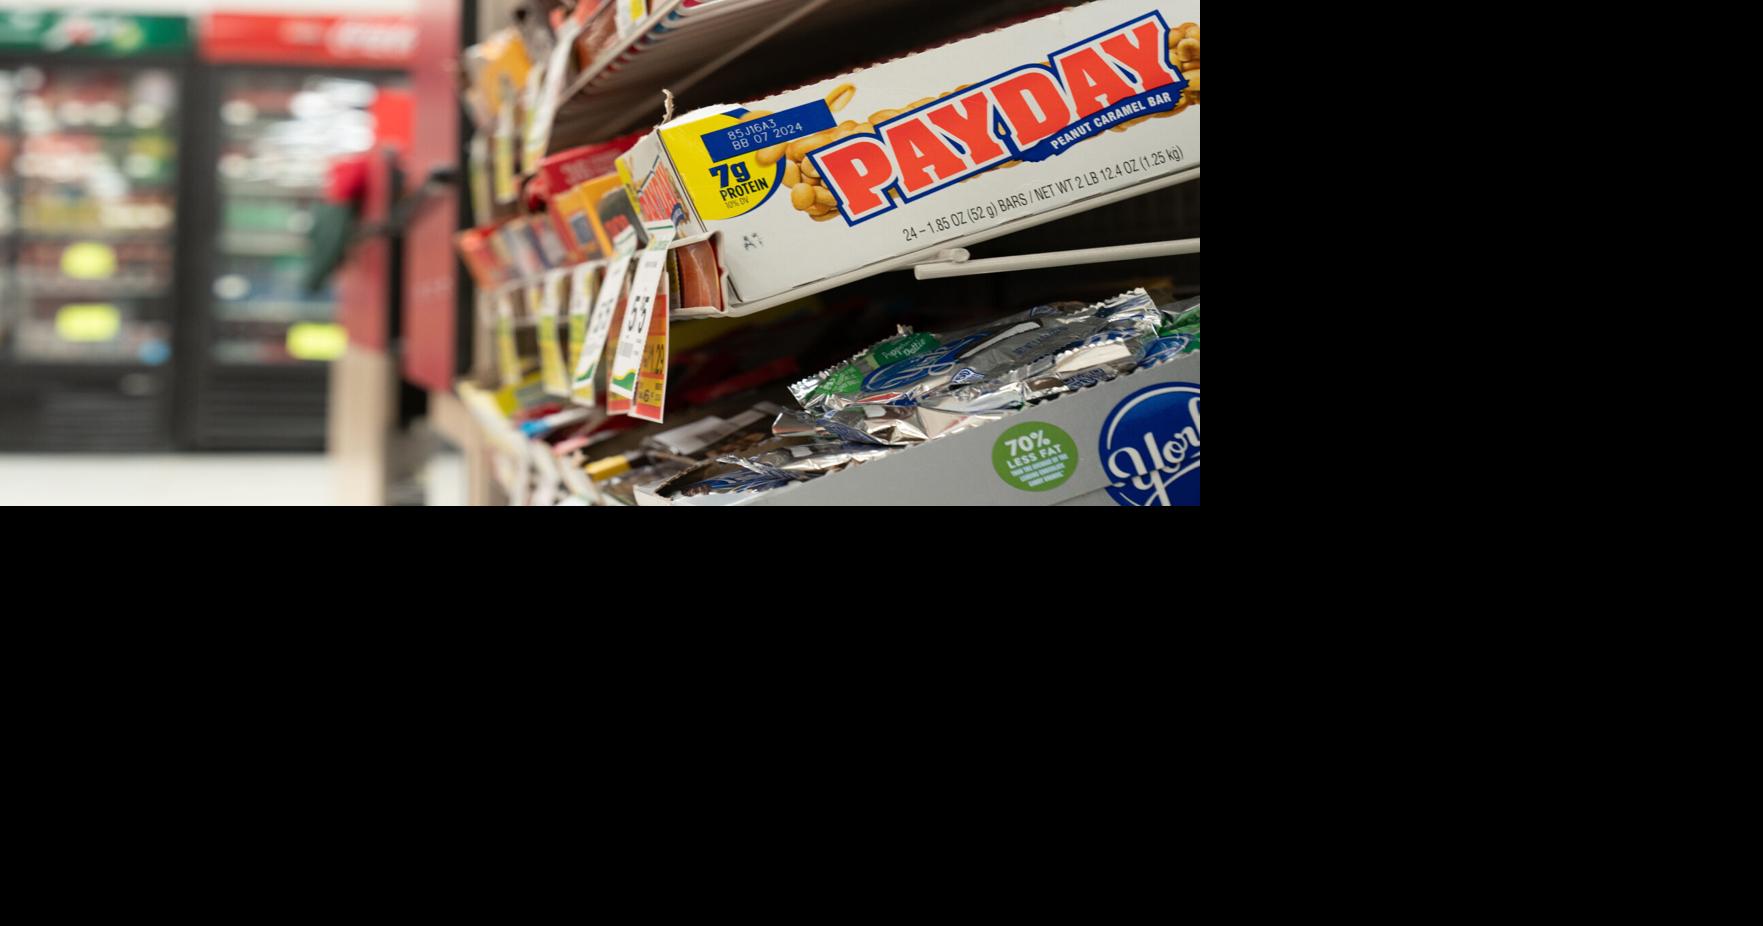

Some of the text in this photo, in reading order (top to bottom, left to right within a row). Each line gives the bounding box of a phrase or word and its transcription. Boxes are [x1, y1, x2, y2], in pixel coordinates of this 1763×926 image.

[727, 119, 777, 141] 85J16A3
[815, 16, 1180, 220] PAYDAY
[1050, 92, 1171, 149] PEANUT CARAMEL BAR
[732, 122, 802, 150] BB 07 2024
[709, 161, 751, 188] 7g
[720, 177, 769, 201] PROTEIN
[903, 226, 918, 241] 24
[927, 217, 950, 234] 1.85
[951, 211, 967, 226] OZ
[967, 206, 985, 223] (52
[987, 202, 998, 219] g)
[998, 193, 1028, 212] BARS
[1034, 184, 1055, 201] NET
[1055, 179, 1074, 194] WT
[1075, 176, 1084, 189] 2
[1085, 171, 1100, 186] LB
[1100, 164, 1123, 181] 12.4
[1123, 159, 1139, 174] OZ
[1139, 151, 1166, 171] (1.25
[1167, 144, 1184, 162] kg)
[1004, 429, 1052, 457] 70%
[1007, 450, 1038, 469] LESS
[1040, 444, 1063, 459] FAT
